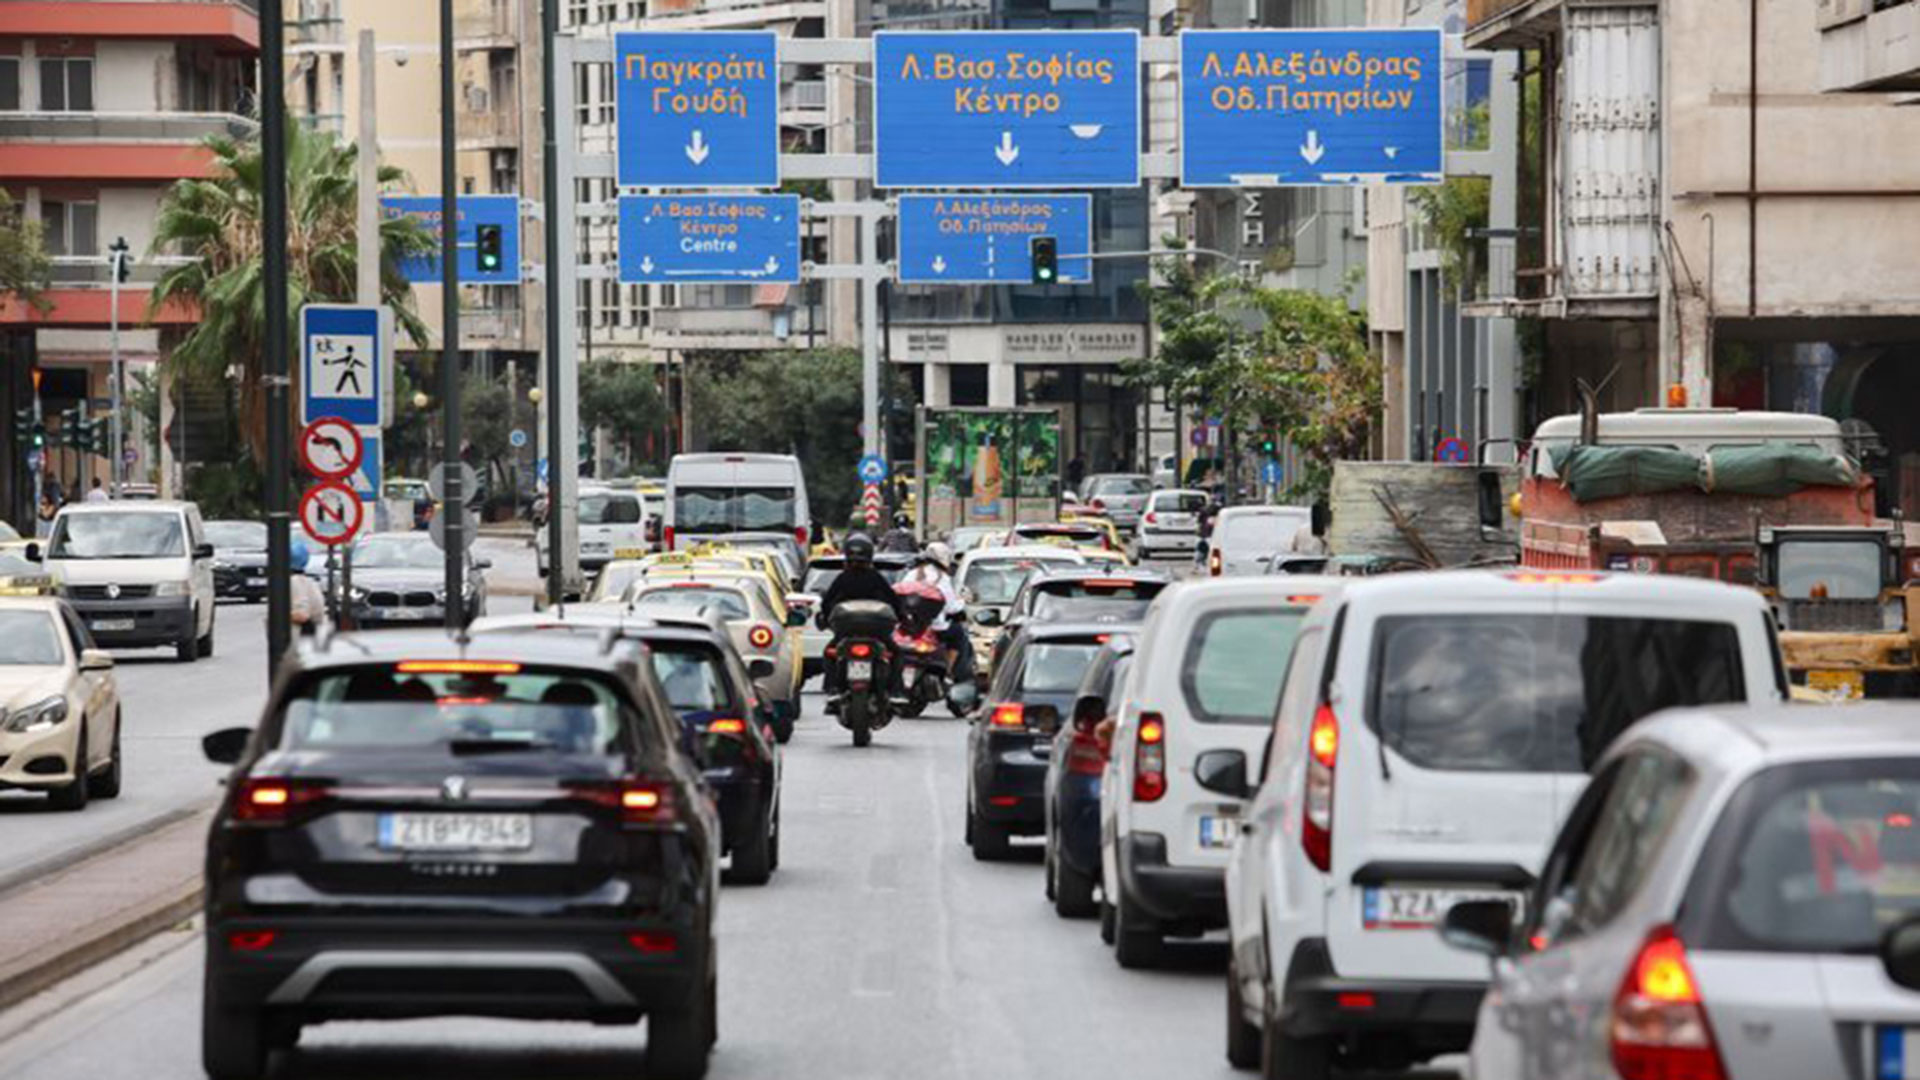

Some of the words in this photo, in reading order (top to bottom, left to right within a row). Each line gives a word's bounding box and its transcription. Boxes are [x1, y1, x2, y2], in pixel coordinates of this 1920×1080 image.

[625, 53, 766, 86] Παγκράτι
[653, 87, 748, 117] Γουδή
[954, 85, 1060, 118] Κέντρο
[680, 237, 738, 252] Centre
